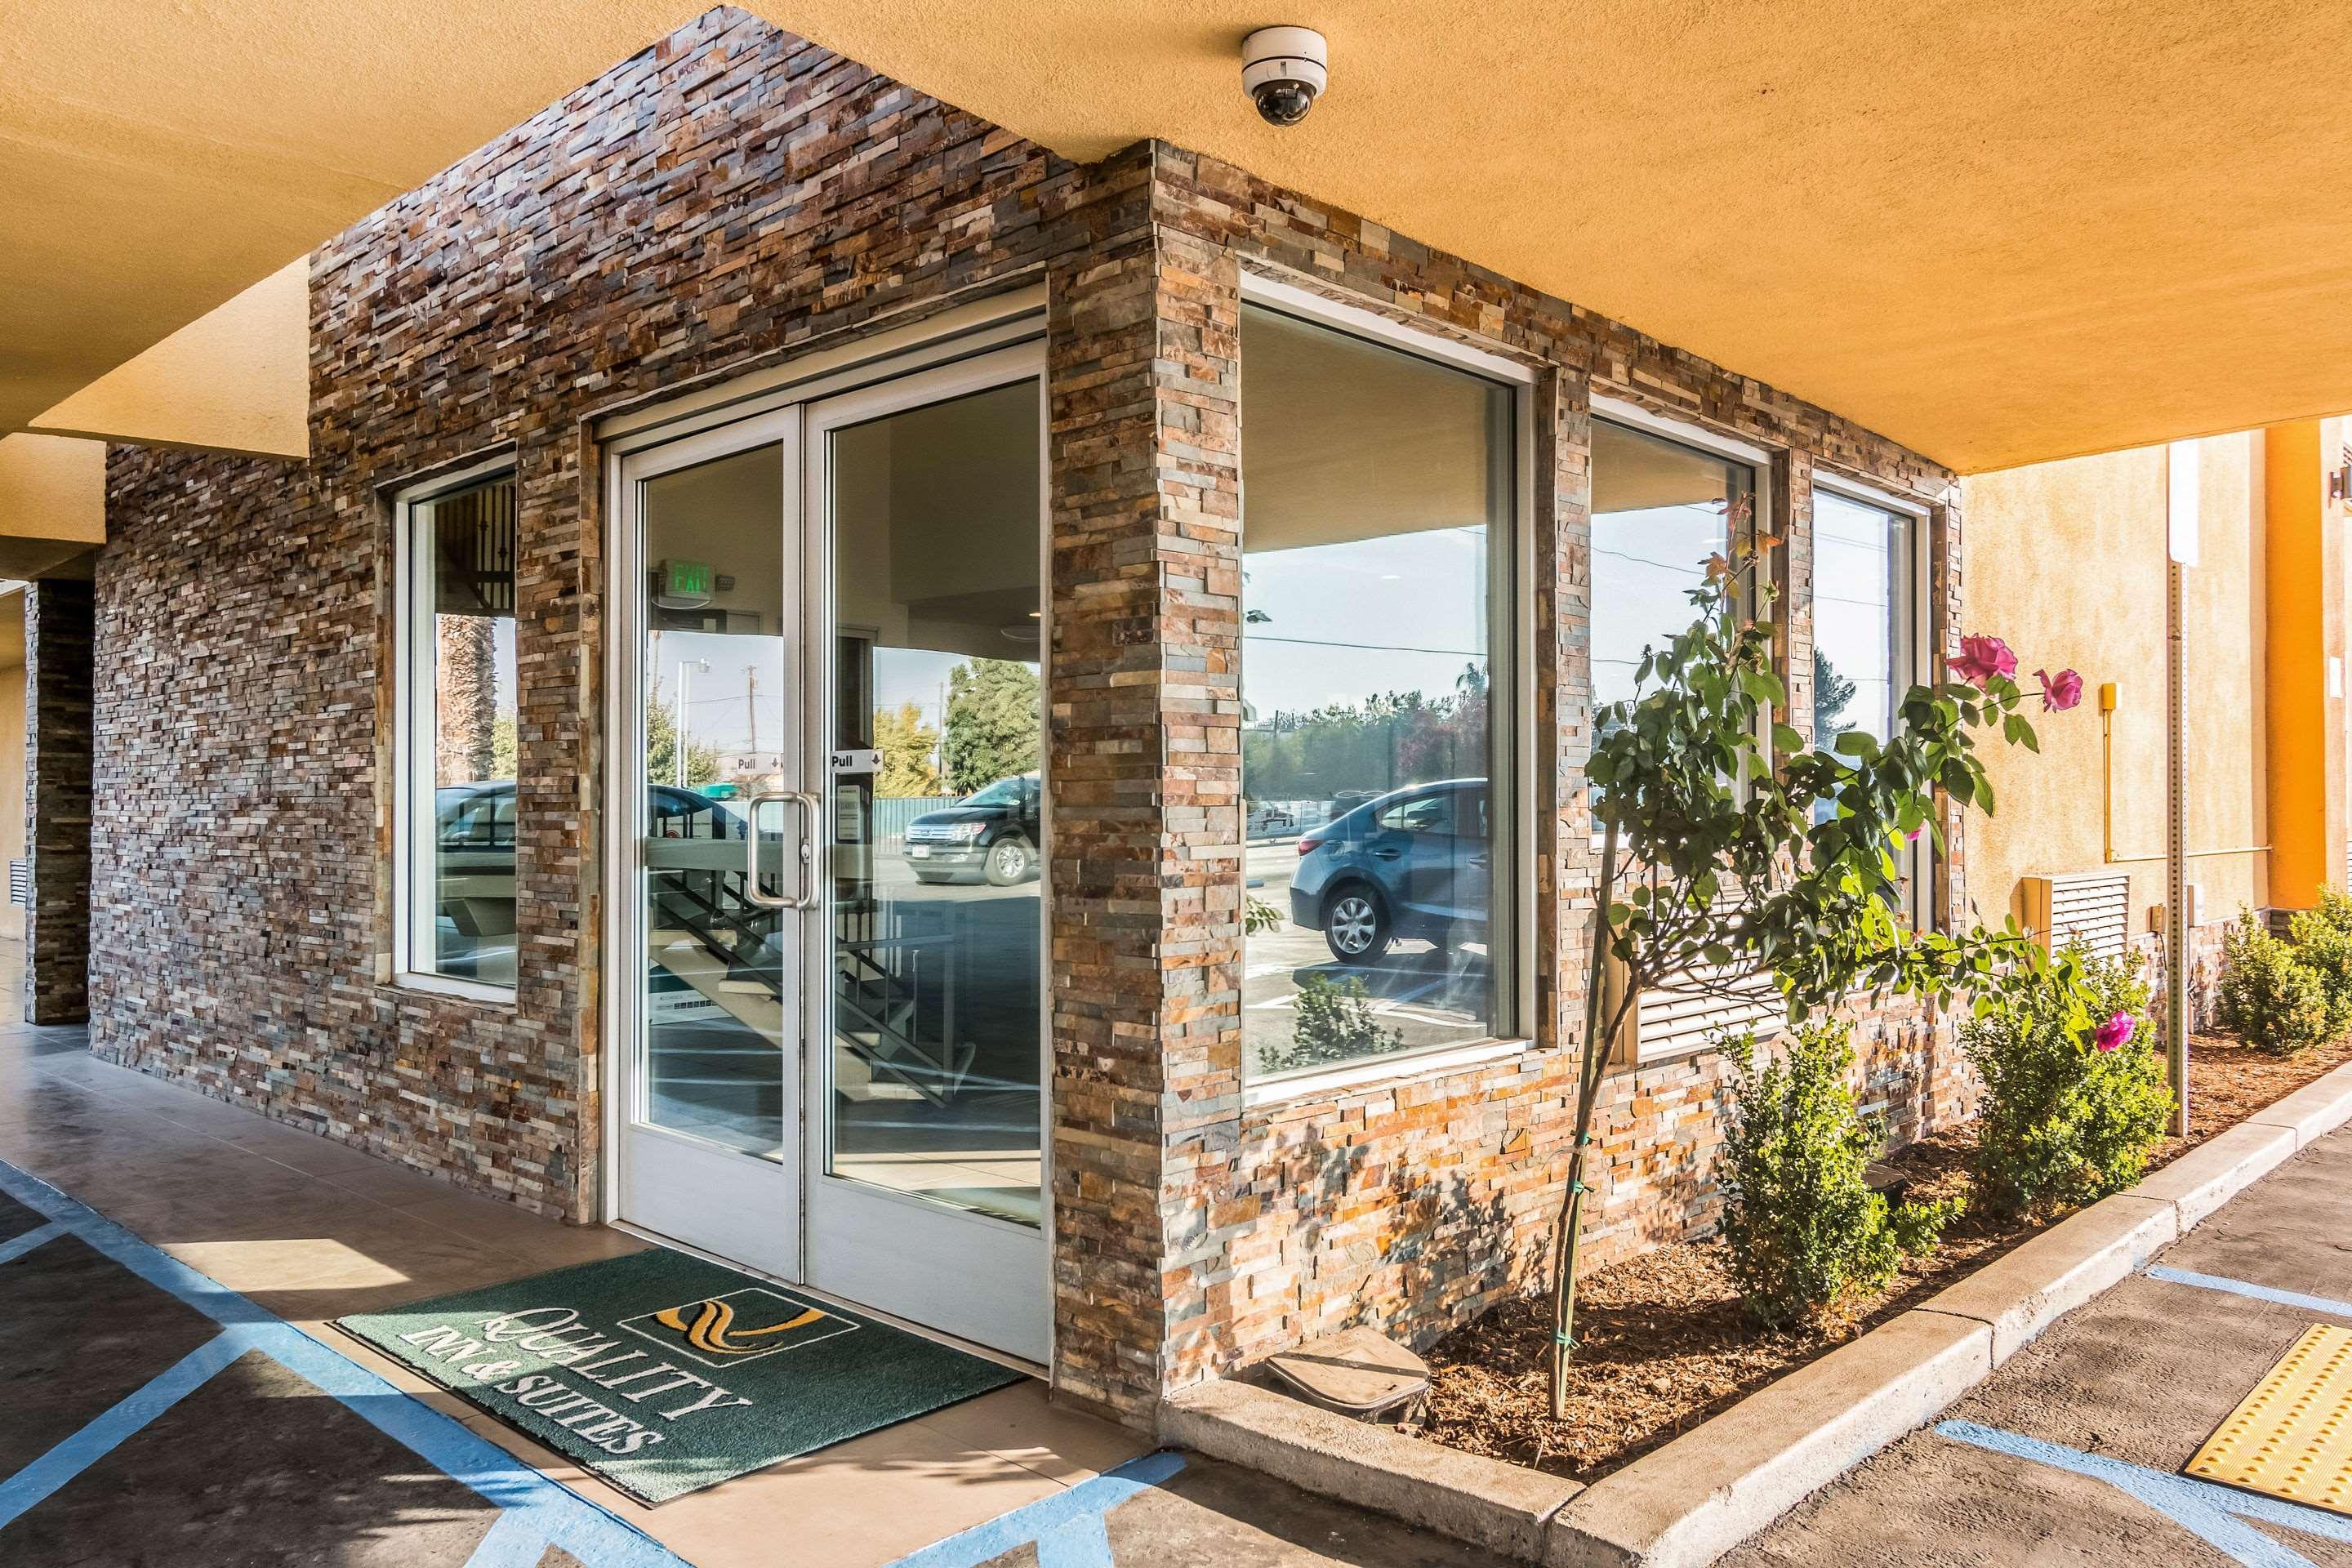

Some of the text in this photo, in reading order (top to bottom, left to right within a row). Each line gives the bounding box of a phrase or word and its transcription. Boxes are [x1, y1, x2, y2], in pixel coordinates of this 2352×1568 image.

[738, 759, 755, 769] Pull
[831, 755, 853, 767] Pull
[399, 1325, 665, 1454] INN & SUITES
[477, 1307, 752, 1421] QUALITY
